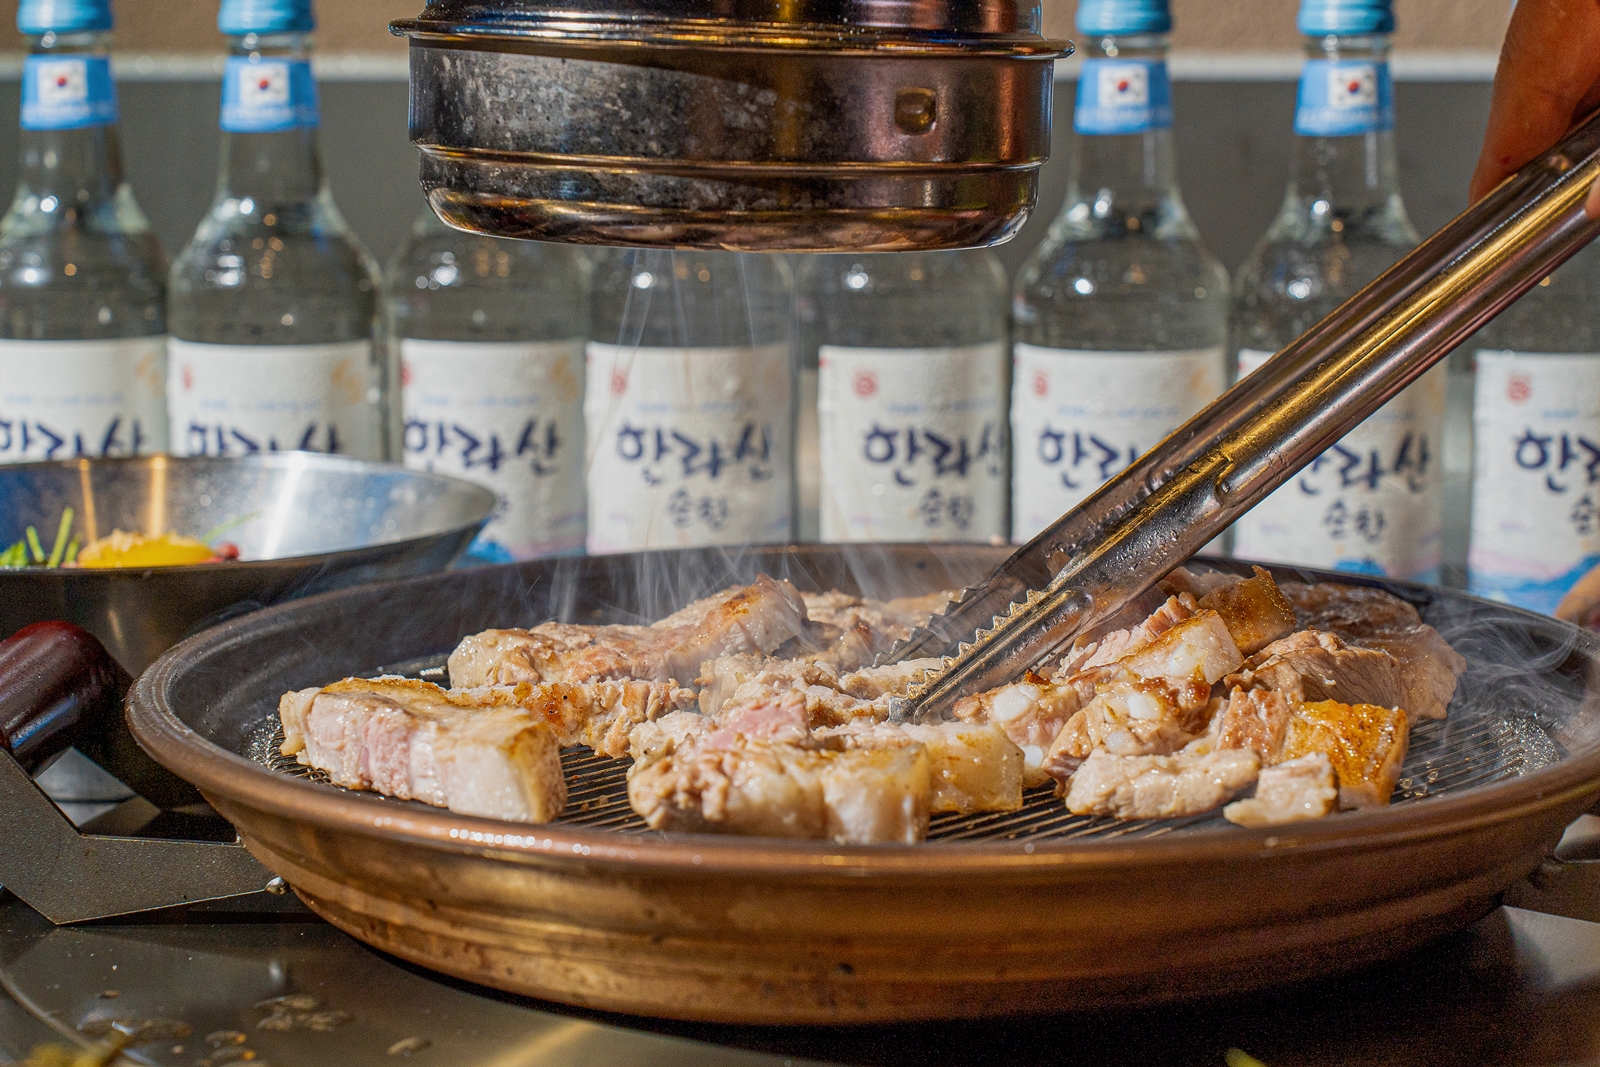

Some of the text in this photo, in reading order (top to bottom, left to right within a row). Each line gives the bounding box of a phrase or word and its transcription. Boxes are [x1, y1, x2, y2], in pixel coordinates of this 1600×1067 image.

[617, 420, 773, 487] 한라산
[1038, 424, 1172, 489] 한라
[666, 486, 729, 531] 순한
[920, 488, 975, 531] 순한
[1324, 501, 1386, 545] 순한
